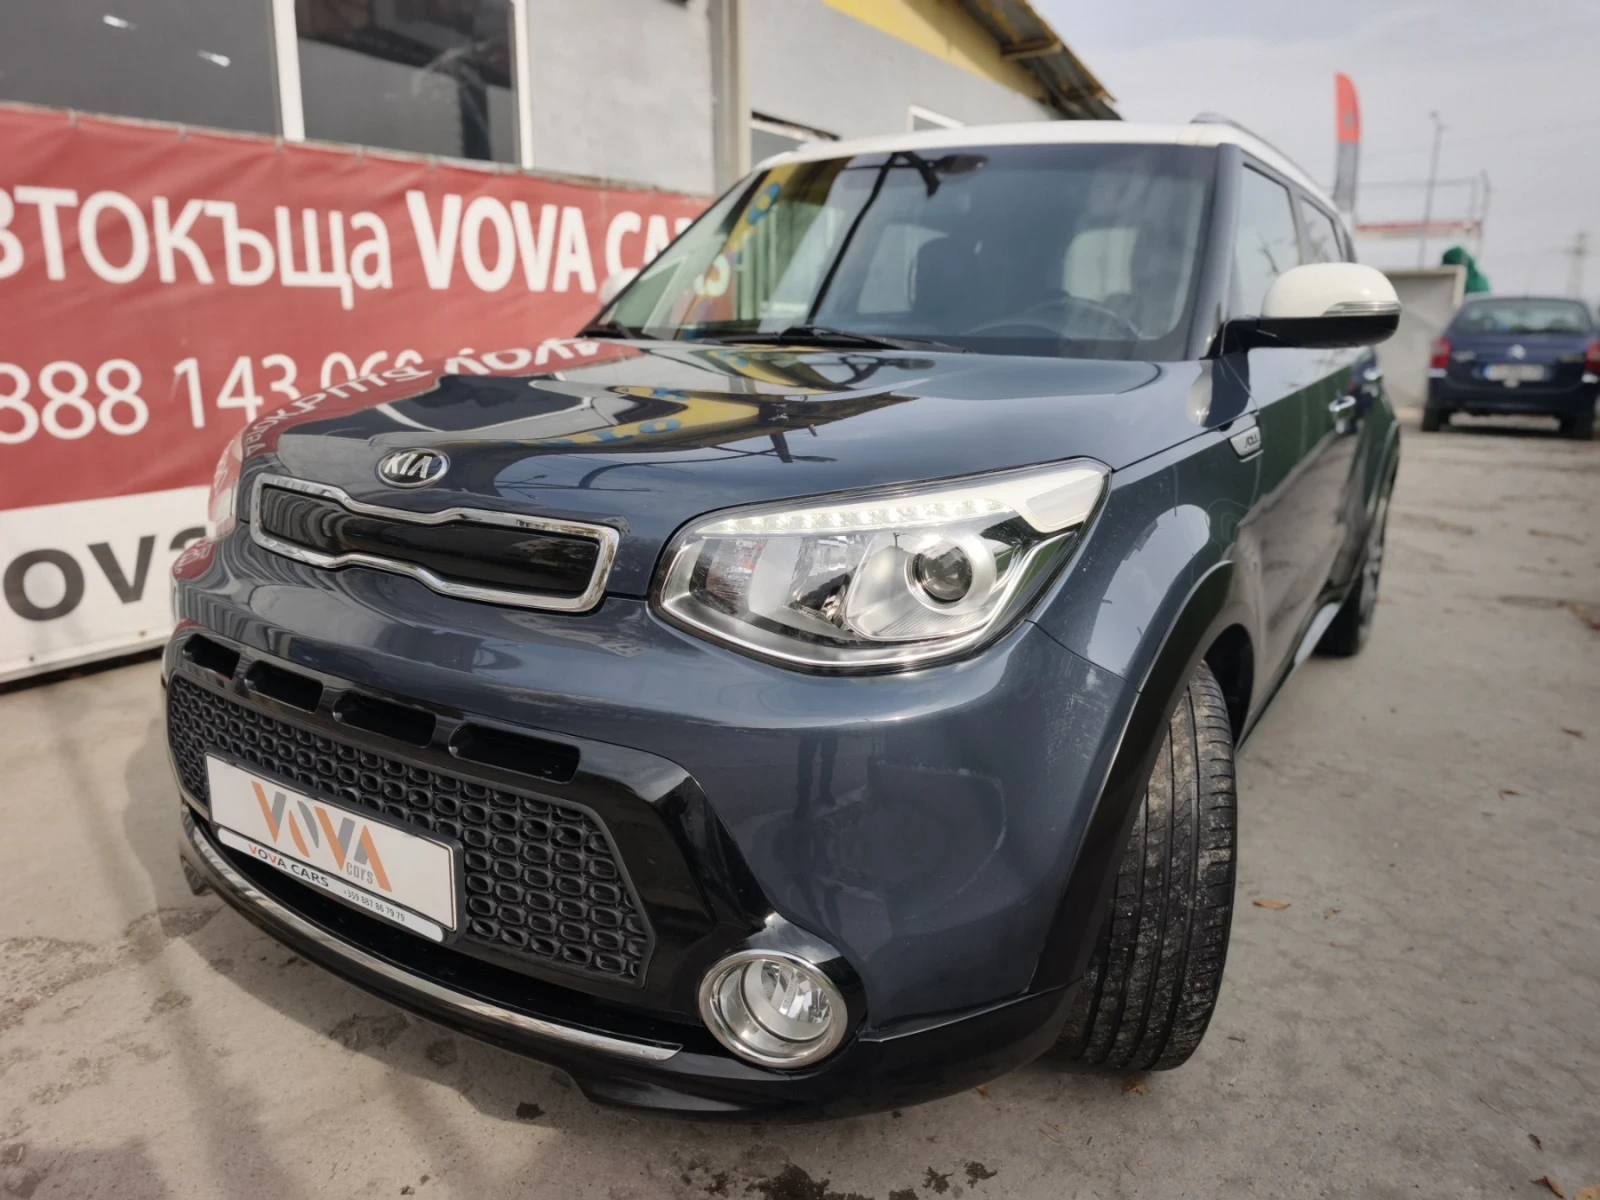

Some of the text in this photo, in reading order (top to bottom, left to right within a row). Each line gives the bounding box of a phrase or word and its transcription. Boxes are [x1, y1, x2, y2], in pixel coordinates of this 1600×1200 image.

[406, 190, 597, 293] VOVA
[0, 358, 149, 445] 888
[173, 353, 301, 429] 143
[383, 452, 433, 478] KIA
[251, 780, 392, 893] VOVA
[248, 843, 330, 888] VOVA CARS
[346, 861, 373, 885] cars
[385, 906, 395, 917] 79
[396, 911, 406, 922] 79
